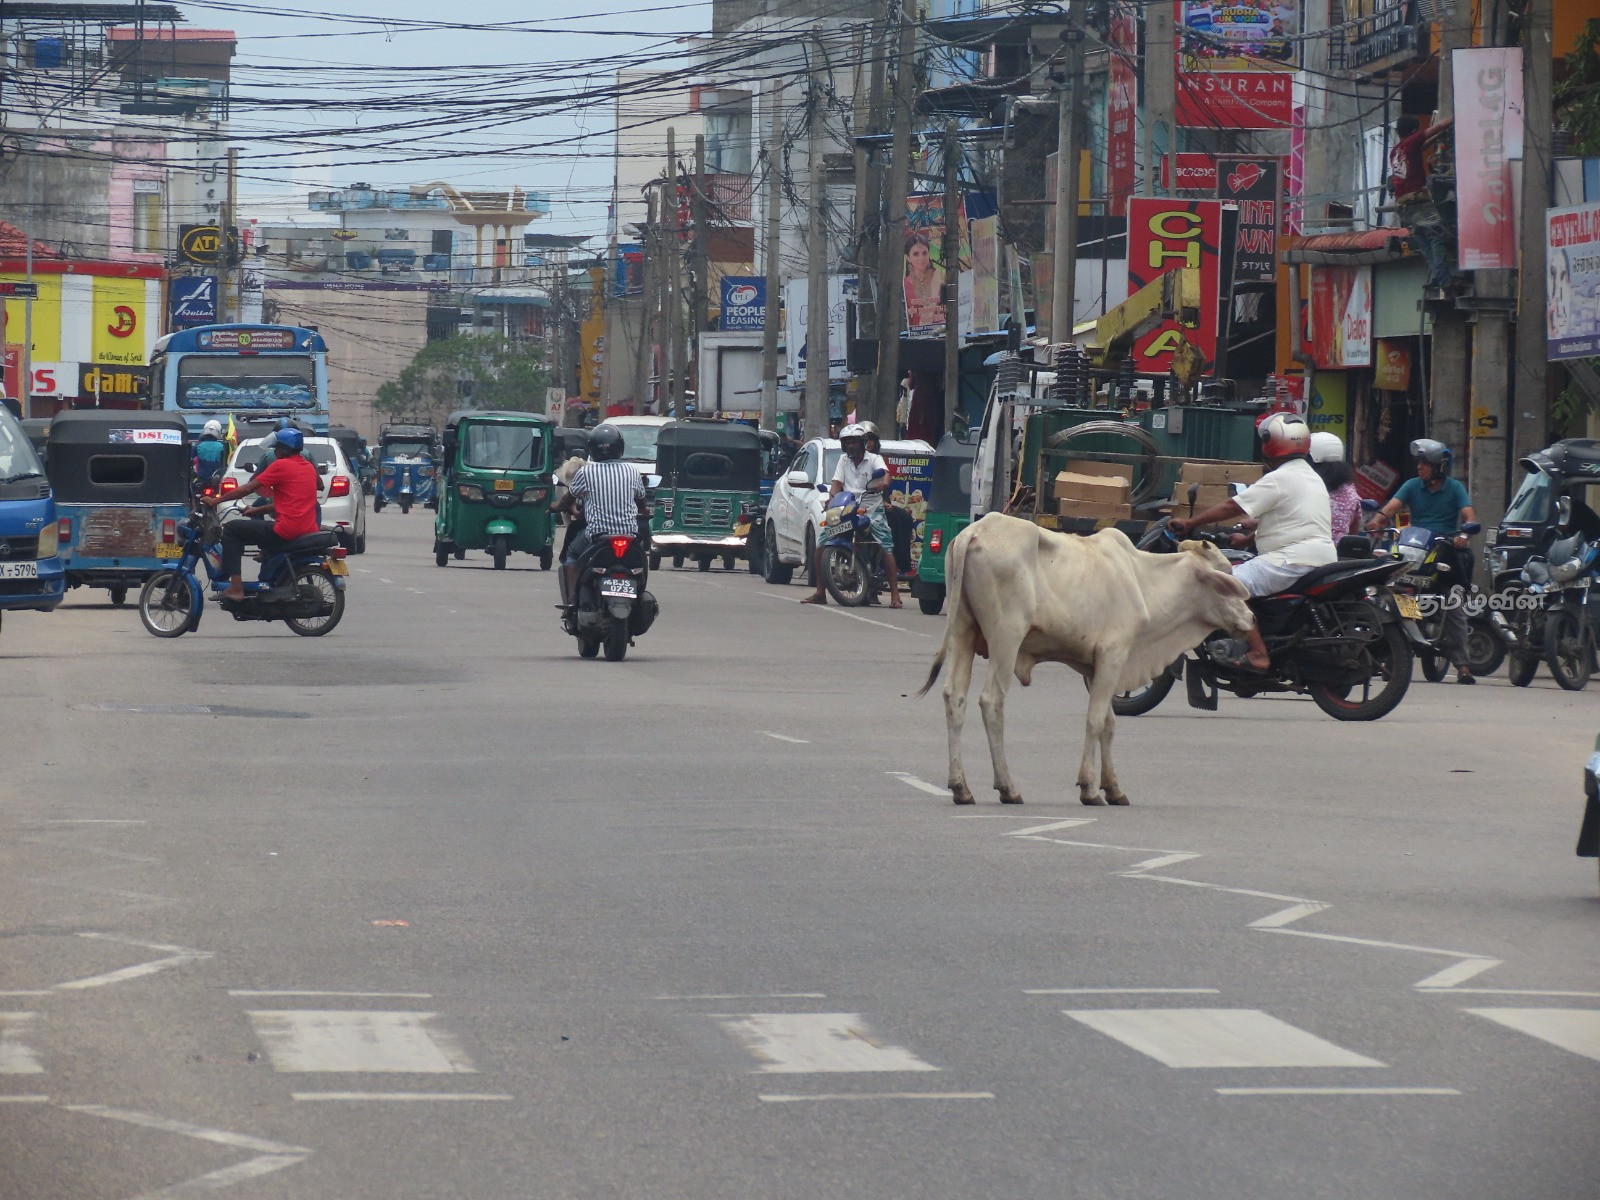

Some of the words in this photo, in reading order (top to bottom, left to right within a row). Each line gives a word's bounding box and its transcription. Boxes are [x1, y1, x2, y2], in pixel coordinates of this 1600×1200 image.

[1250, 99, 1286, 108] Company
[1477, 67, 1505, 111] 4G
[1478, 117, 1506, 195] airtel
[1550, 212, 1591, 248] CENTRAL
[1242, 261, 1270, 270] STYLE
[1144, 212, 1202, 357] CHA
[726, 316, 766, 325] LEASING
[1347, 313, 1367, 345] Dialog
[137, 432, 162, 440] DSI
[163, 433, 180, 441] Tyres
